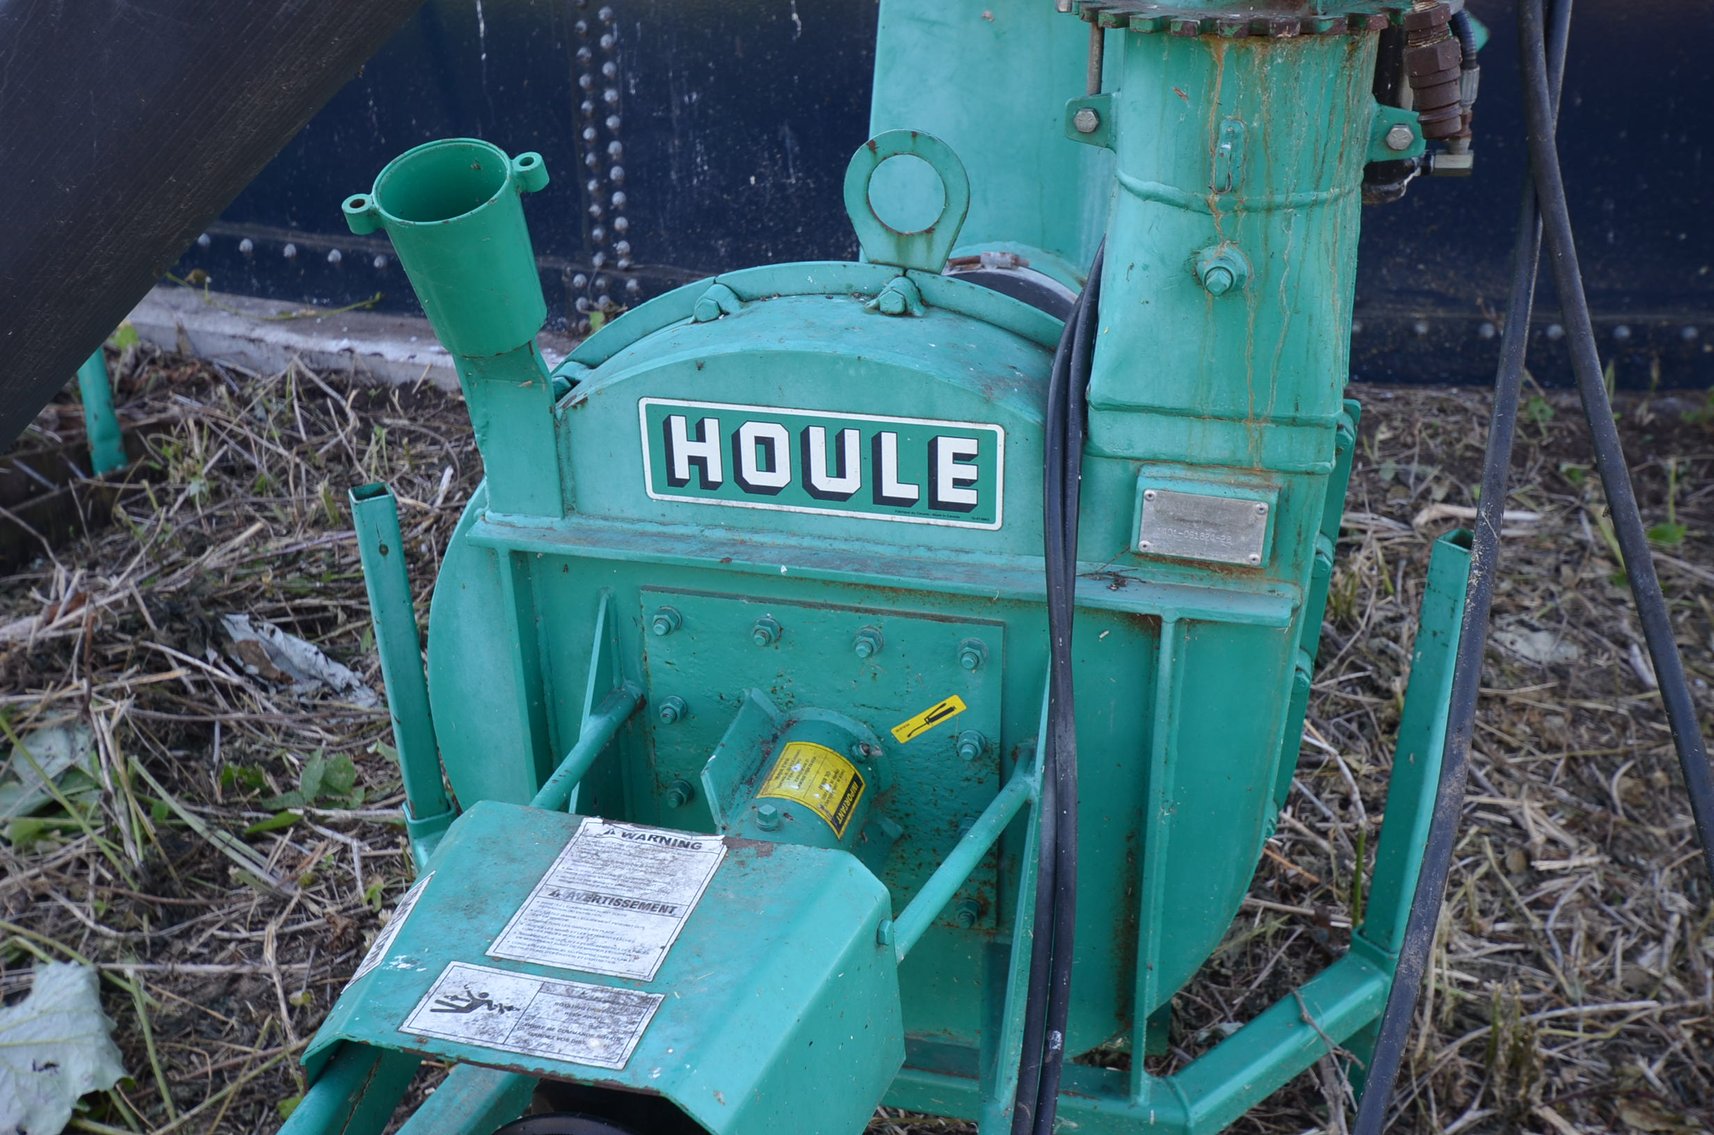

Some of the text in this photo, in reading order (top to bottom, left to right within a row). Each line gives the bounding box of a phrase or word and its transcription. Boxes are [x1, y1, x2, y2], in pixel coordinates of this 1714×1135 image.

[663, 414, 979, 513] HOULE
[836, 781, 859, 824] IMPORTANT
[621, 831, 703, 850] WARNING
[564, 889, 678, 914] AVERTISSEMENT
